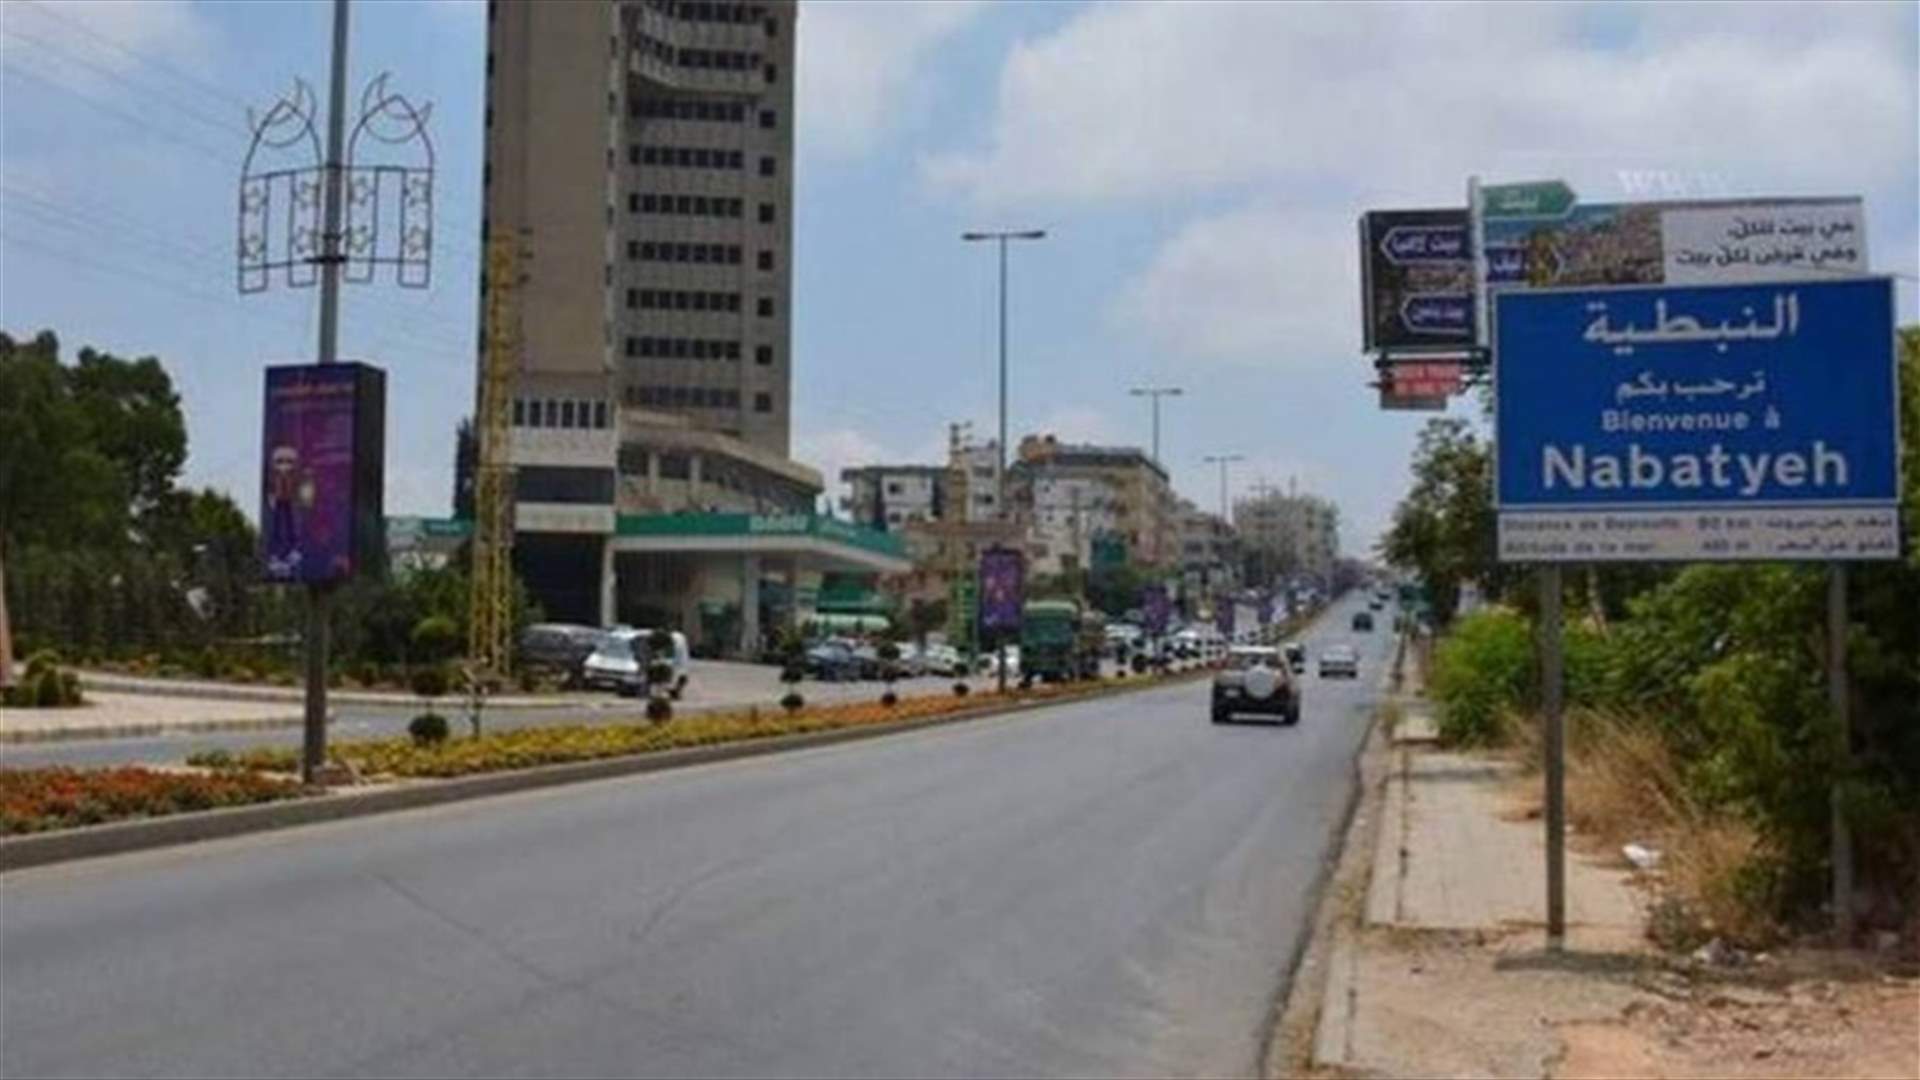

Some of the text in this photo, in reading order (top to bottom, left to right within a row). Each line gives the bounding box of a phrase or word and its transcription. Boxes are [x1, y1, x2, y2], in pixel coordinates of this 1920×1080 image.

[1583, 293, 1798, 355] النبطية
[1616, 371, 1669, 402] بكم
[1602, 404, 1781, 432] Bienvenue à
[1542, 440, 1849, 496] Nabatyeh
